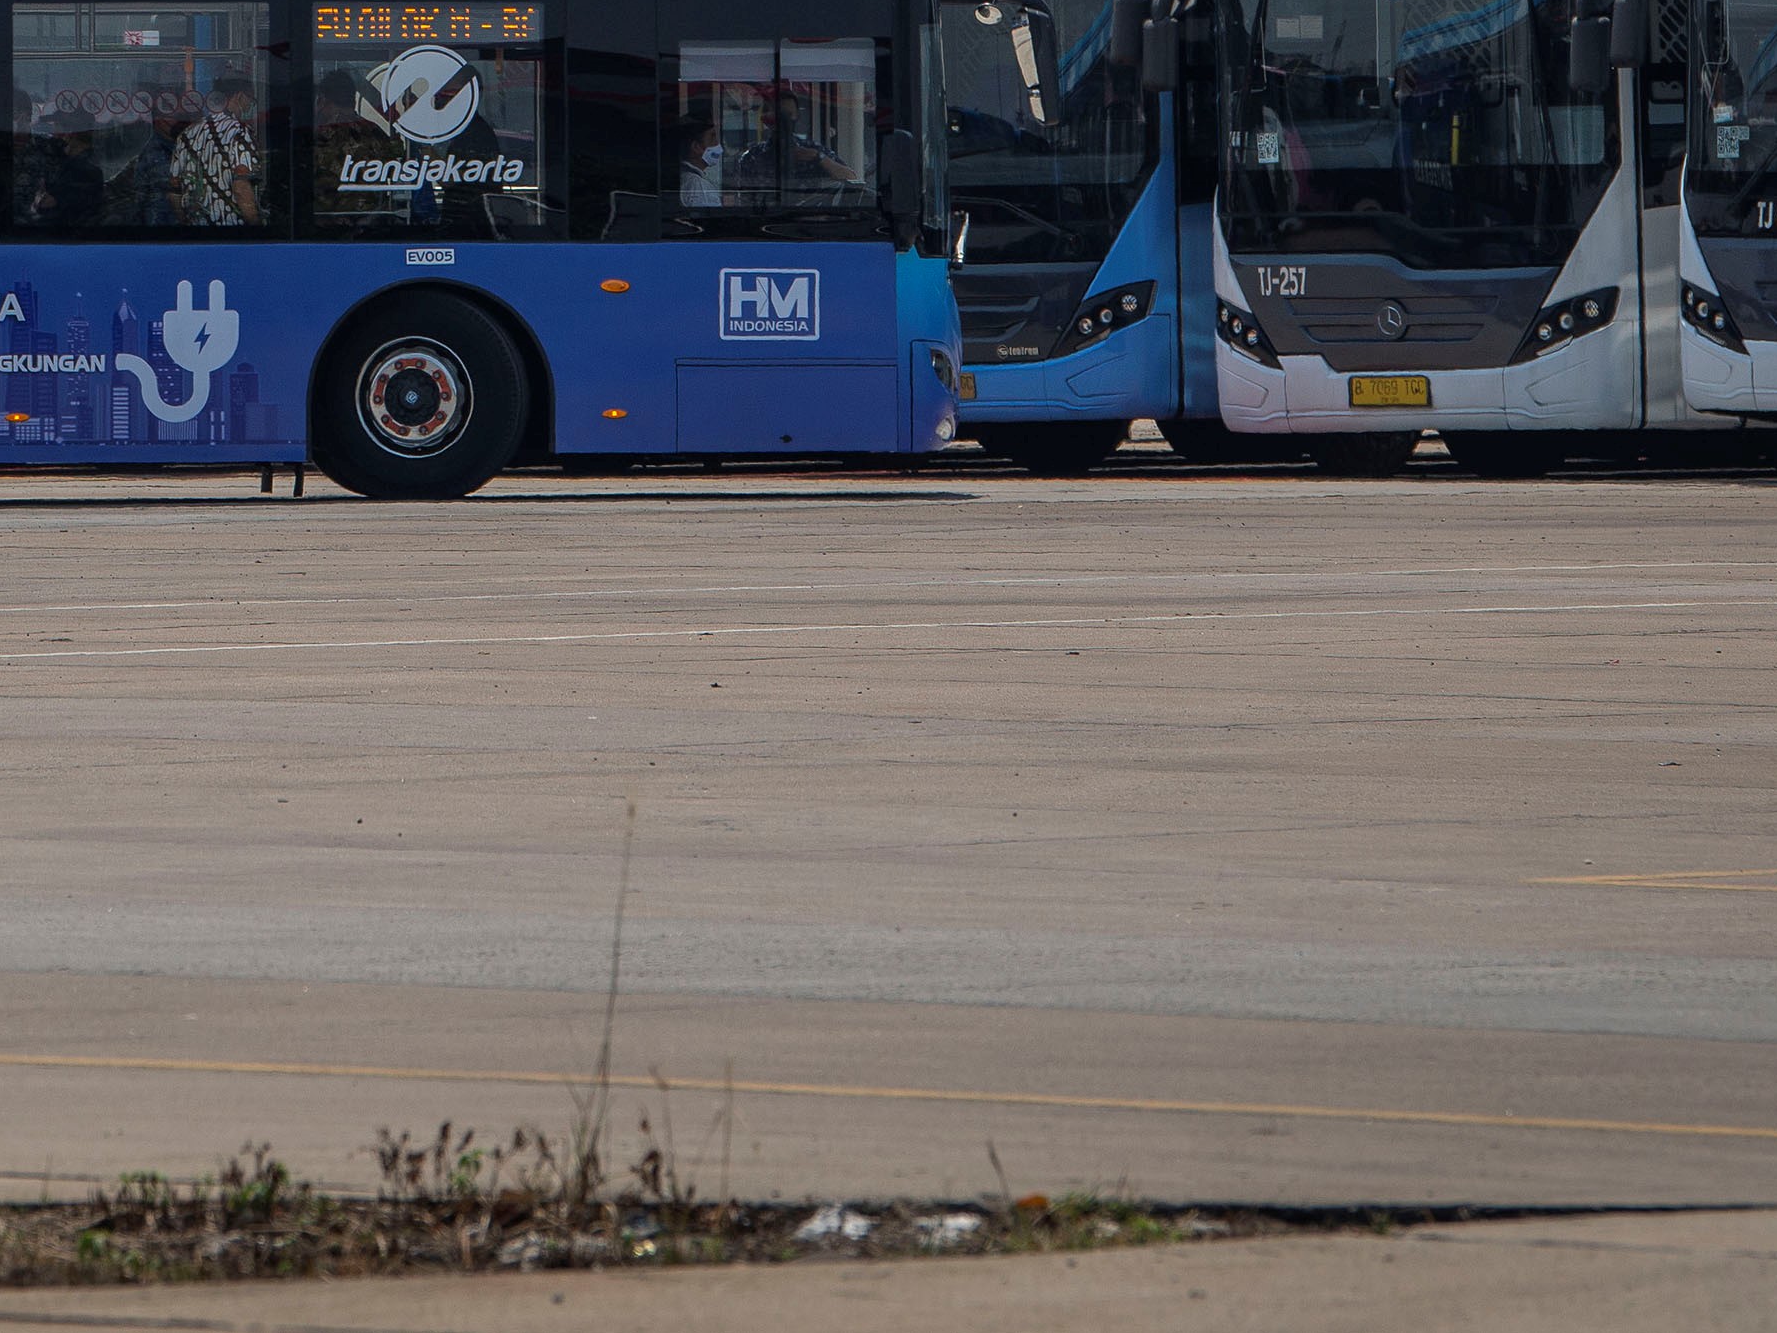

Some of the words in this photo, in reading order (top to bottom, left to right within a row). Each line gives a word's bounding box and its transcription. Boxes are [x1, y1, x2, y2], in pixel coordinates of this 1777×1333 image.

[338, 154, 524, 191] transjakarta
[408, 250, 453, 263] EV005
[1257, 266, 1307, 297] TJ-257
[729, 276, 809, 319] HM
[729, 320, 809, 332] INDONESIA
